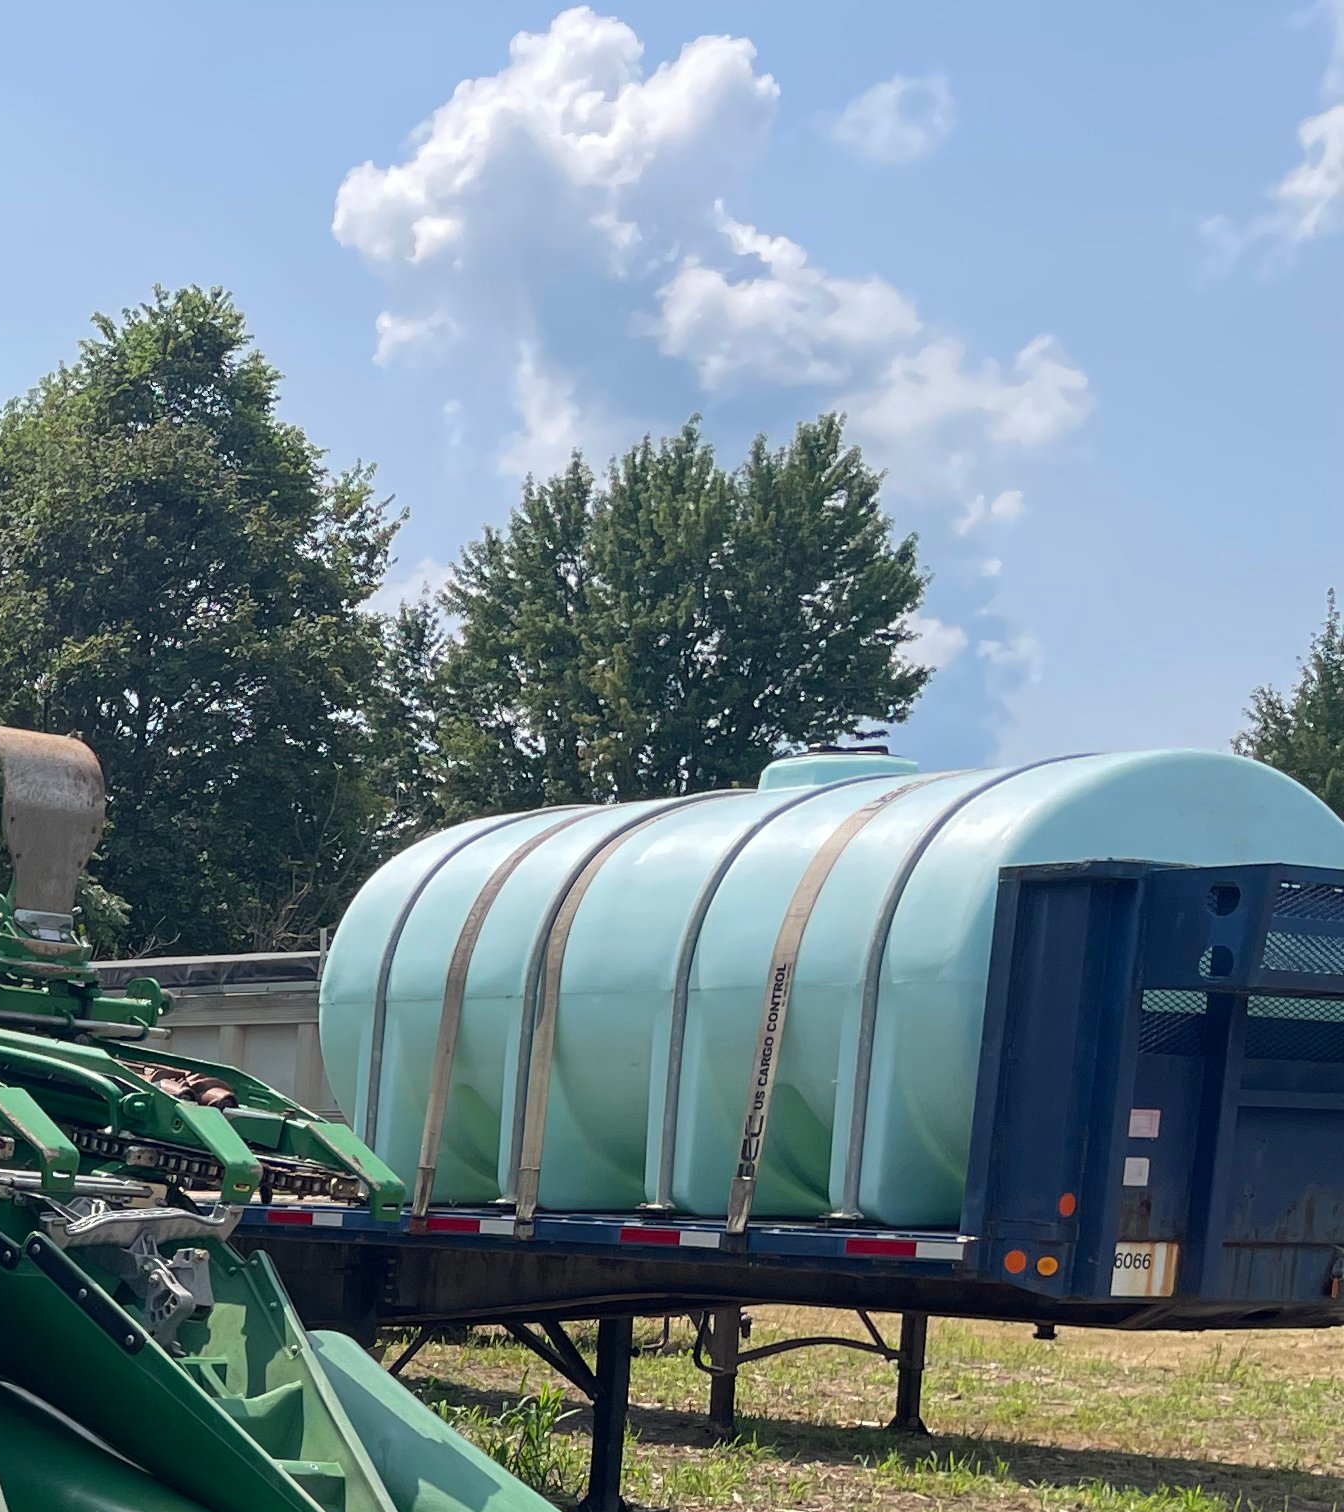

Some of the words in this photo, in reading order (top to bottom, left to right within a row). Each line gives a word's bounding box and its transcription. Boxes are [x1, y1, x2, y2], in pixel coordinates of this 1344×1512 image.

[766, 962, 787, 1032] CONTROL
[757, 1037, 774, 1087] CARGO
[754, 1090, 766, 1110] US
[1114, 1252, 1152, 1269] 6066
